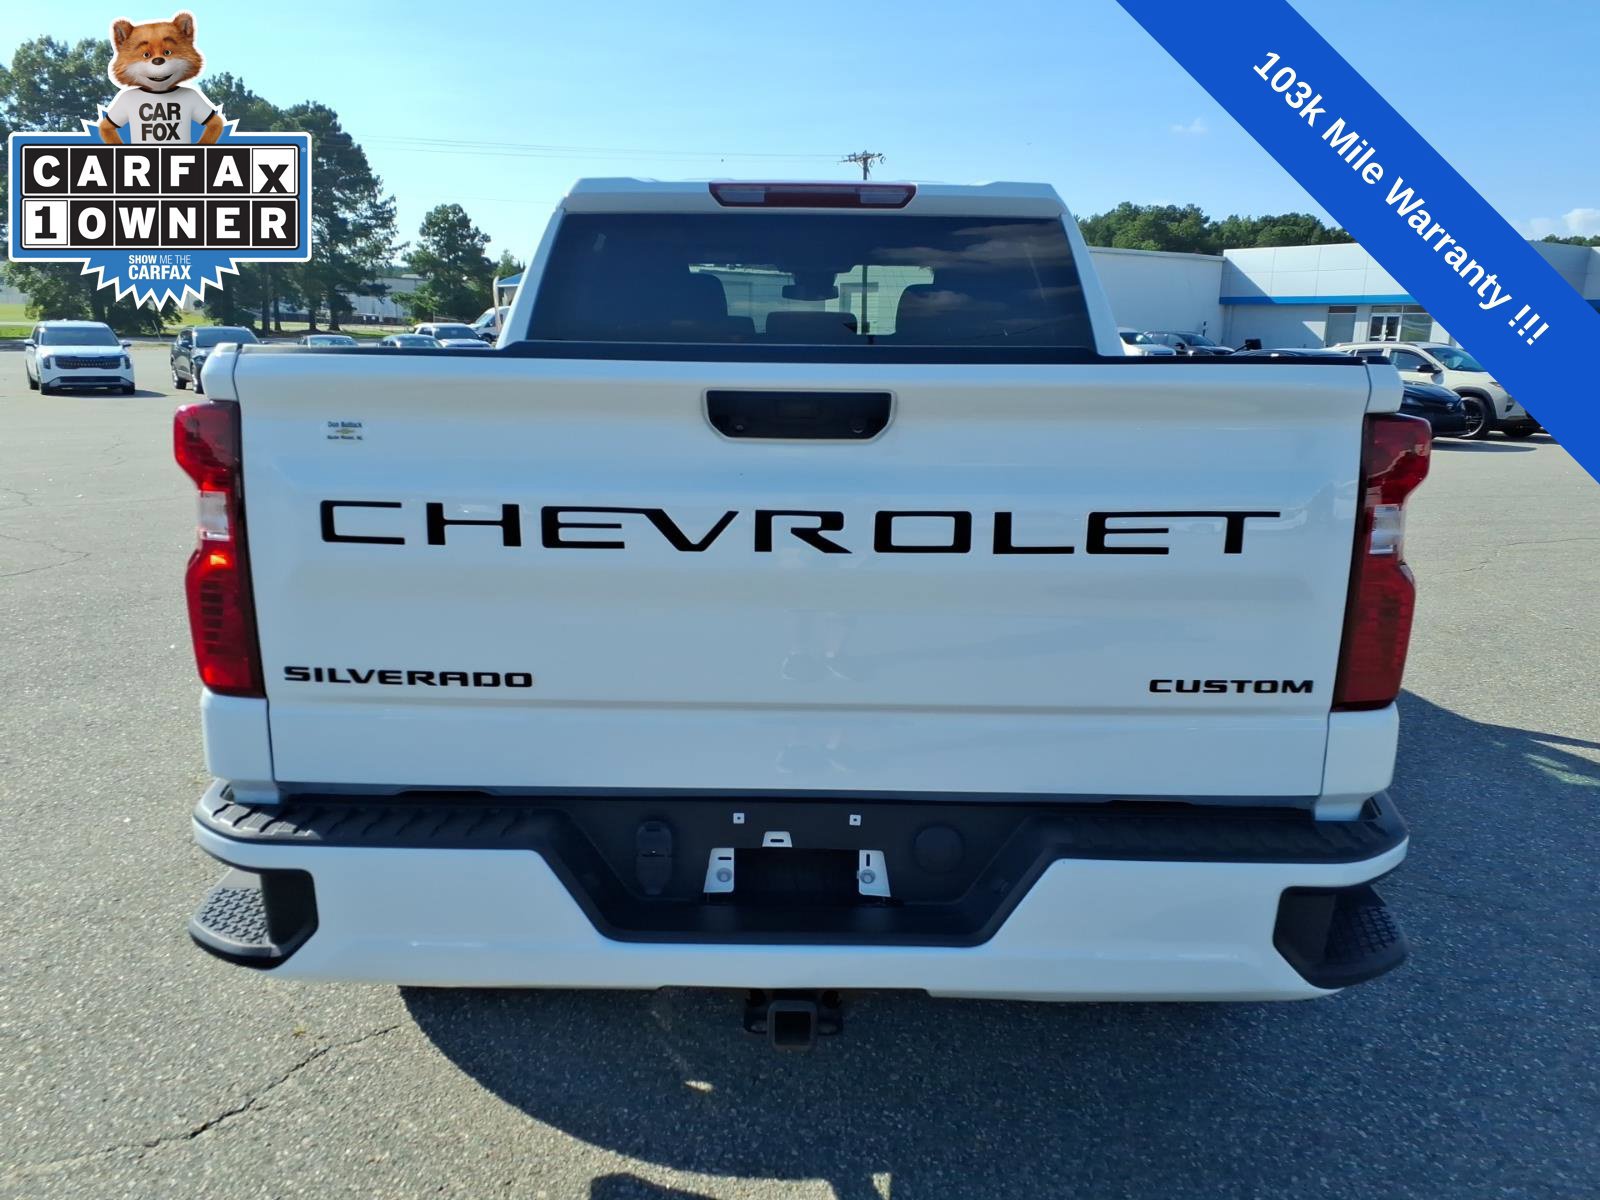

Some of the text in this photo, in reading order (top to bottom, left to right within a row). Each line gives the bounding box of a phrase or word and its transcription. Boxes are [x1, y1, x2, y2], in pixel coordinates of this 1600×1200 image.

[320, 500, 1280, 555] CHEVROLET
[284, 666, 533, 688] SILVERADO
[1149, 679, 1314, 694] CUSTOM
